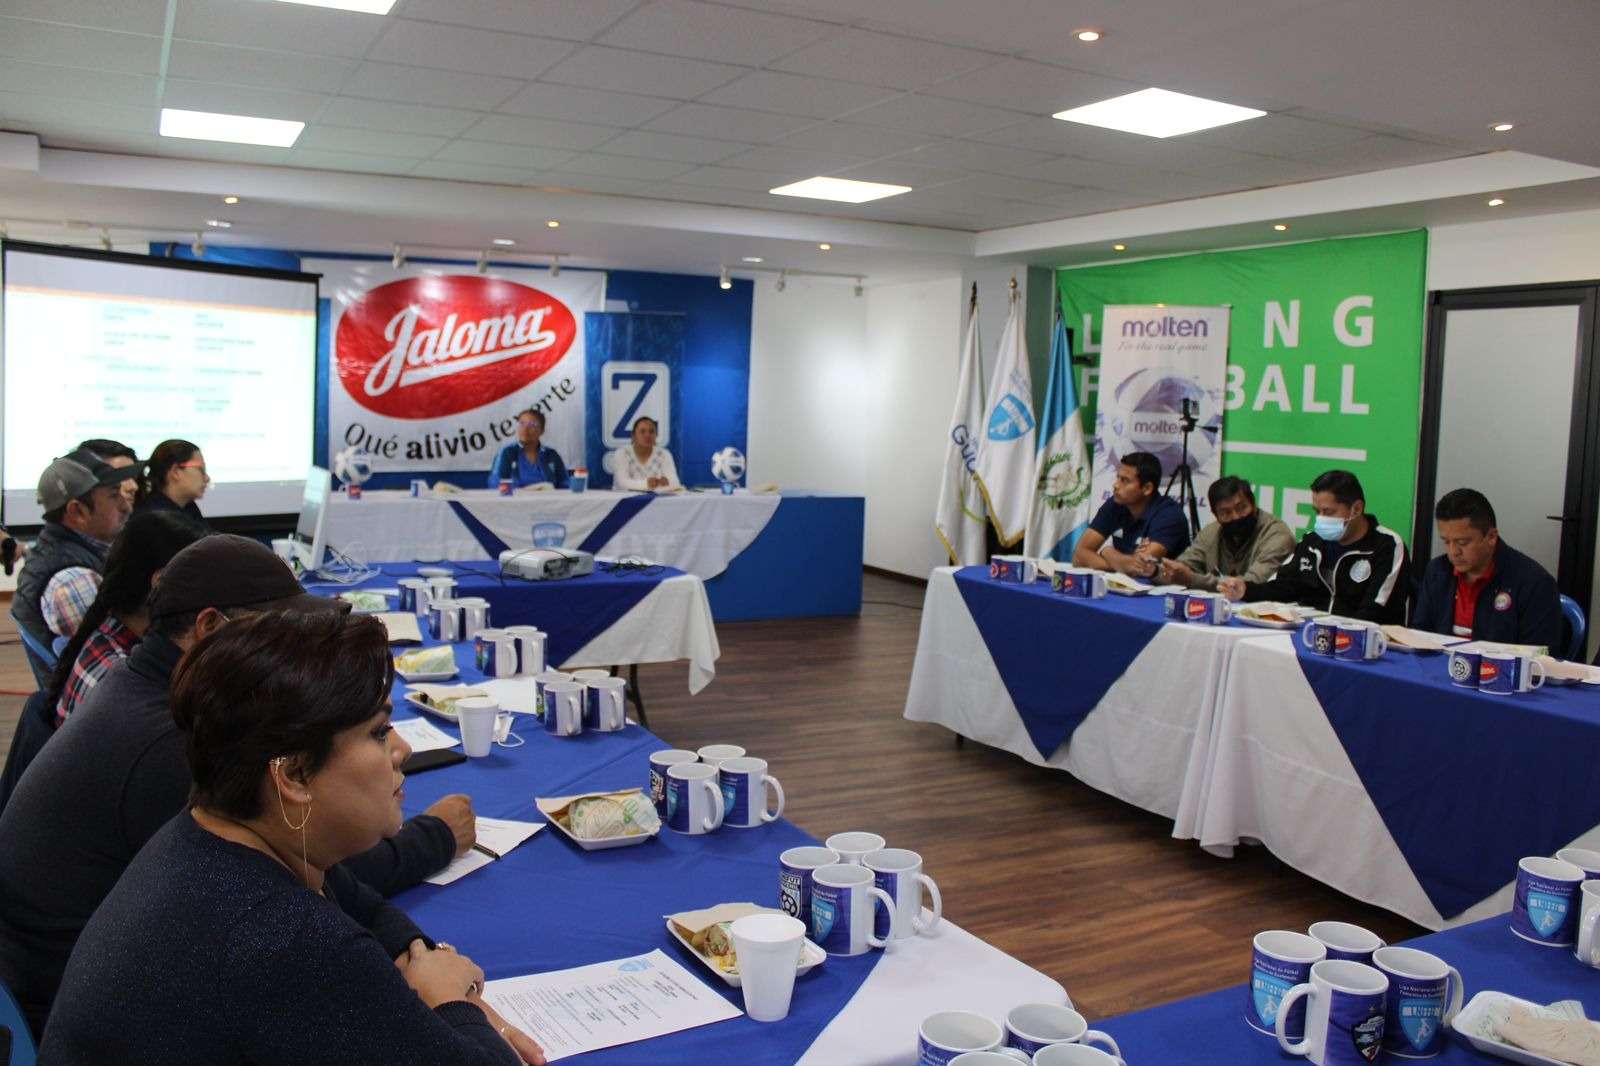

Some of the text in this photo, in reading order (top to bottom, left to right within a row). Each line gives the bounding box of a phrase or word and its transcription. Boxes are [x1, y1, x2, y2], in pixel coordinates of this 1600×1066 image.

[1081, 296, 1375, 353] LNG
[1122, 316, 1208, 337] molten
[364, 303, 556, 397] Jaloma
[1080, 363, 1372, 416] FBALL
[344, 422, 399, 459] Qué
[406, 428, 486, 460] alivio
[1134, 420, 1179, 434] molte
